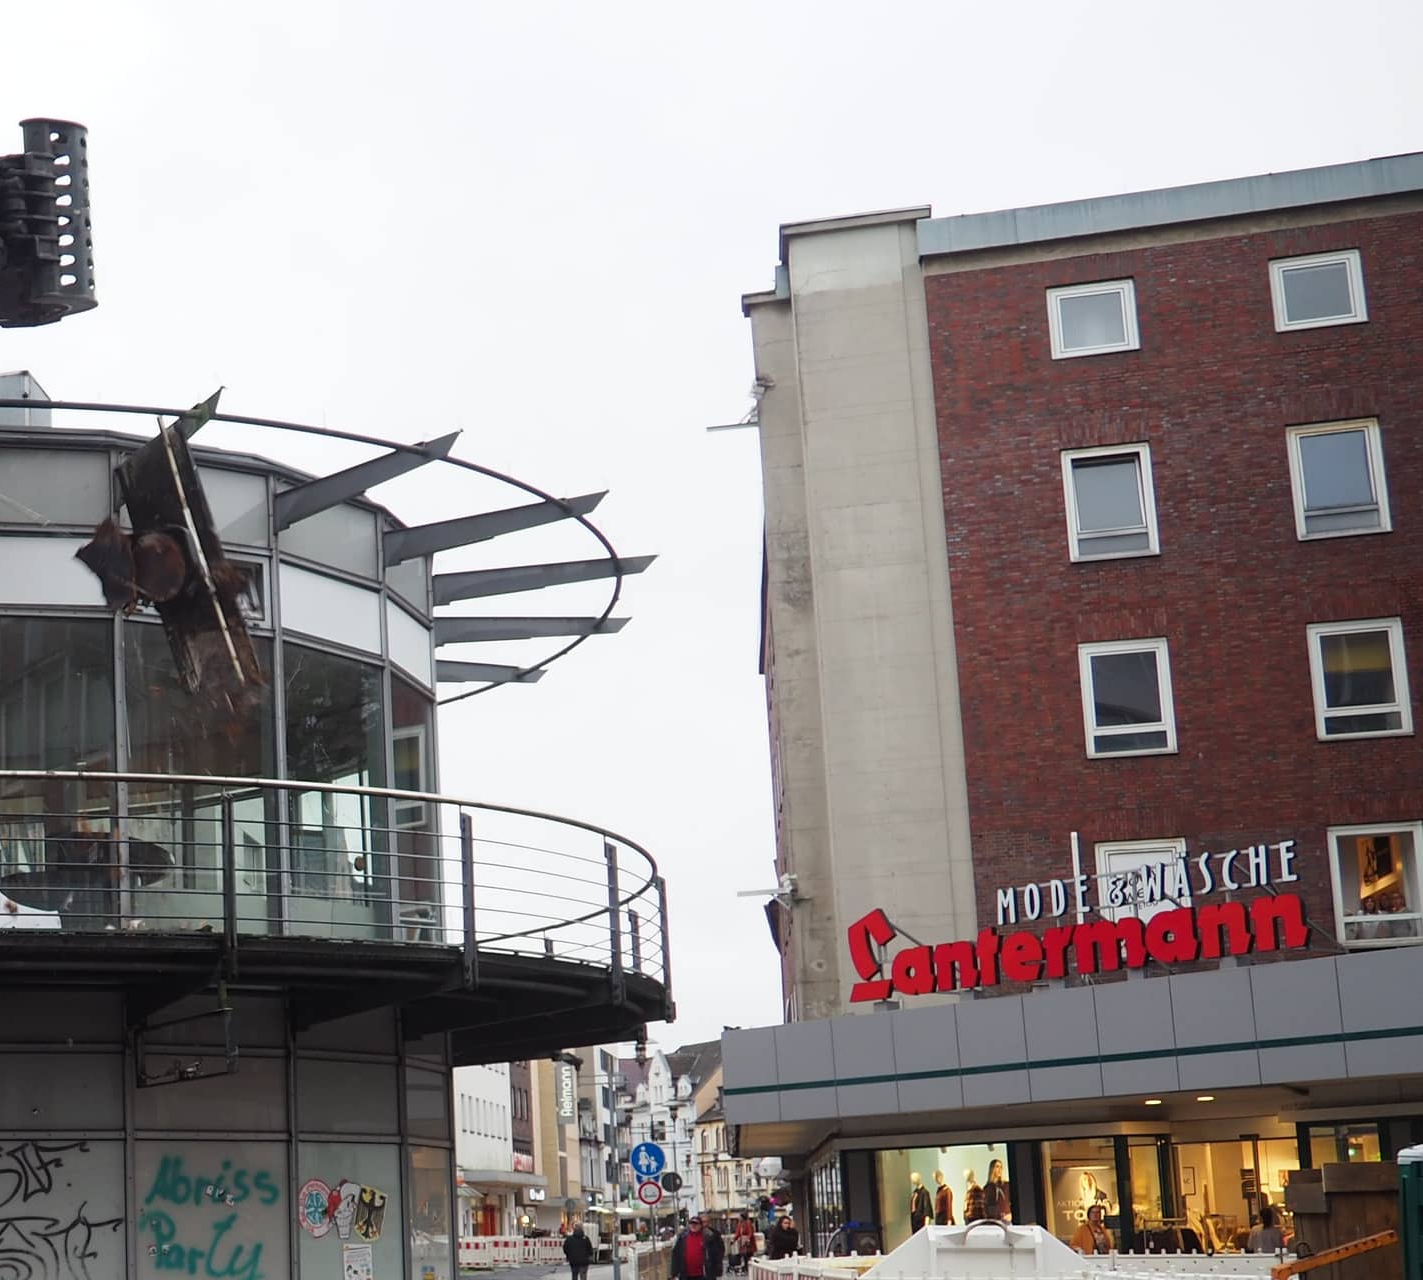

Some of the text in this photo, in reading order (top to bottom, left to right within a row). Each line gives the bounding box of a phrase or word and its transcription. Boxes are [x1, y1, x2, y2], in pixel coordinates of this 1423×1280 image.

[997, 874, 1091, 925] MODE
[1107, 875, 1126, 907] &
[1141, 840, 1299, 902] WÄSCHE
[144, 1155, 280, 1207] Abriss
[138, 1211, 265, 1280] Party
